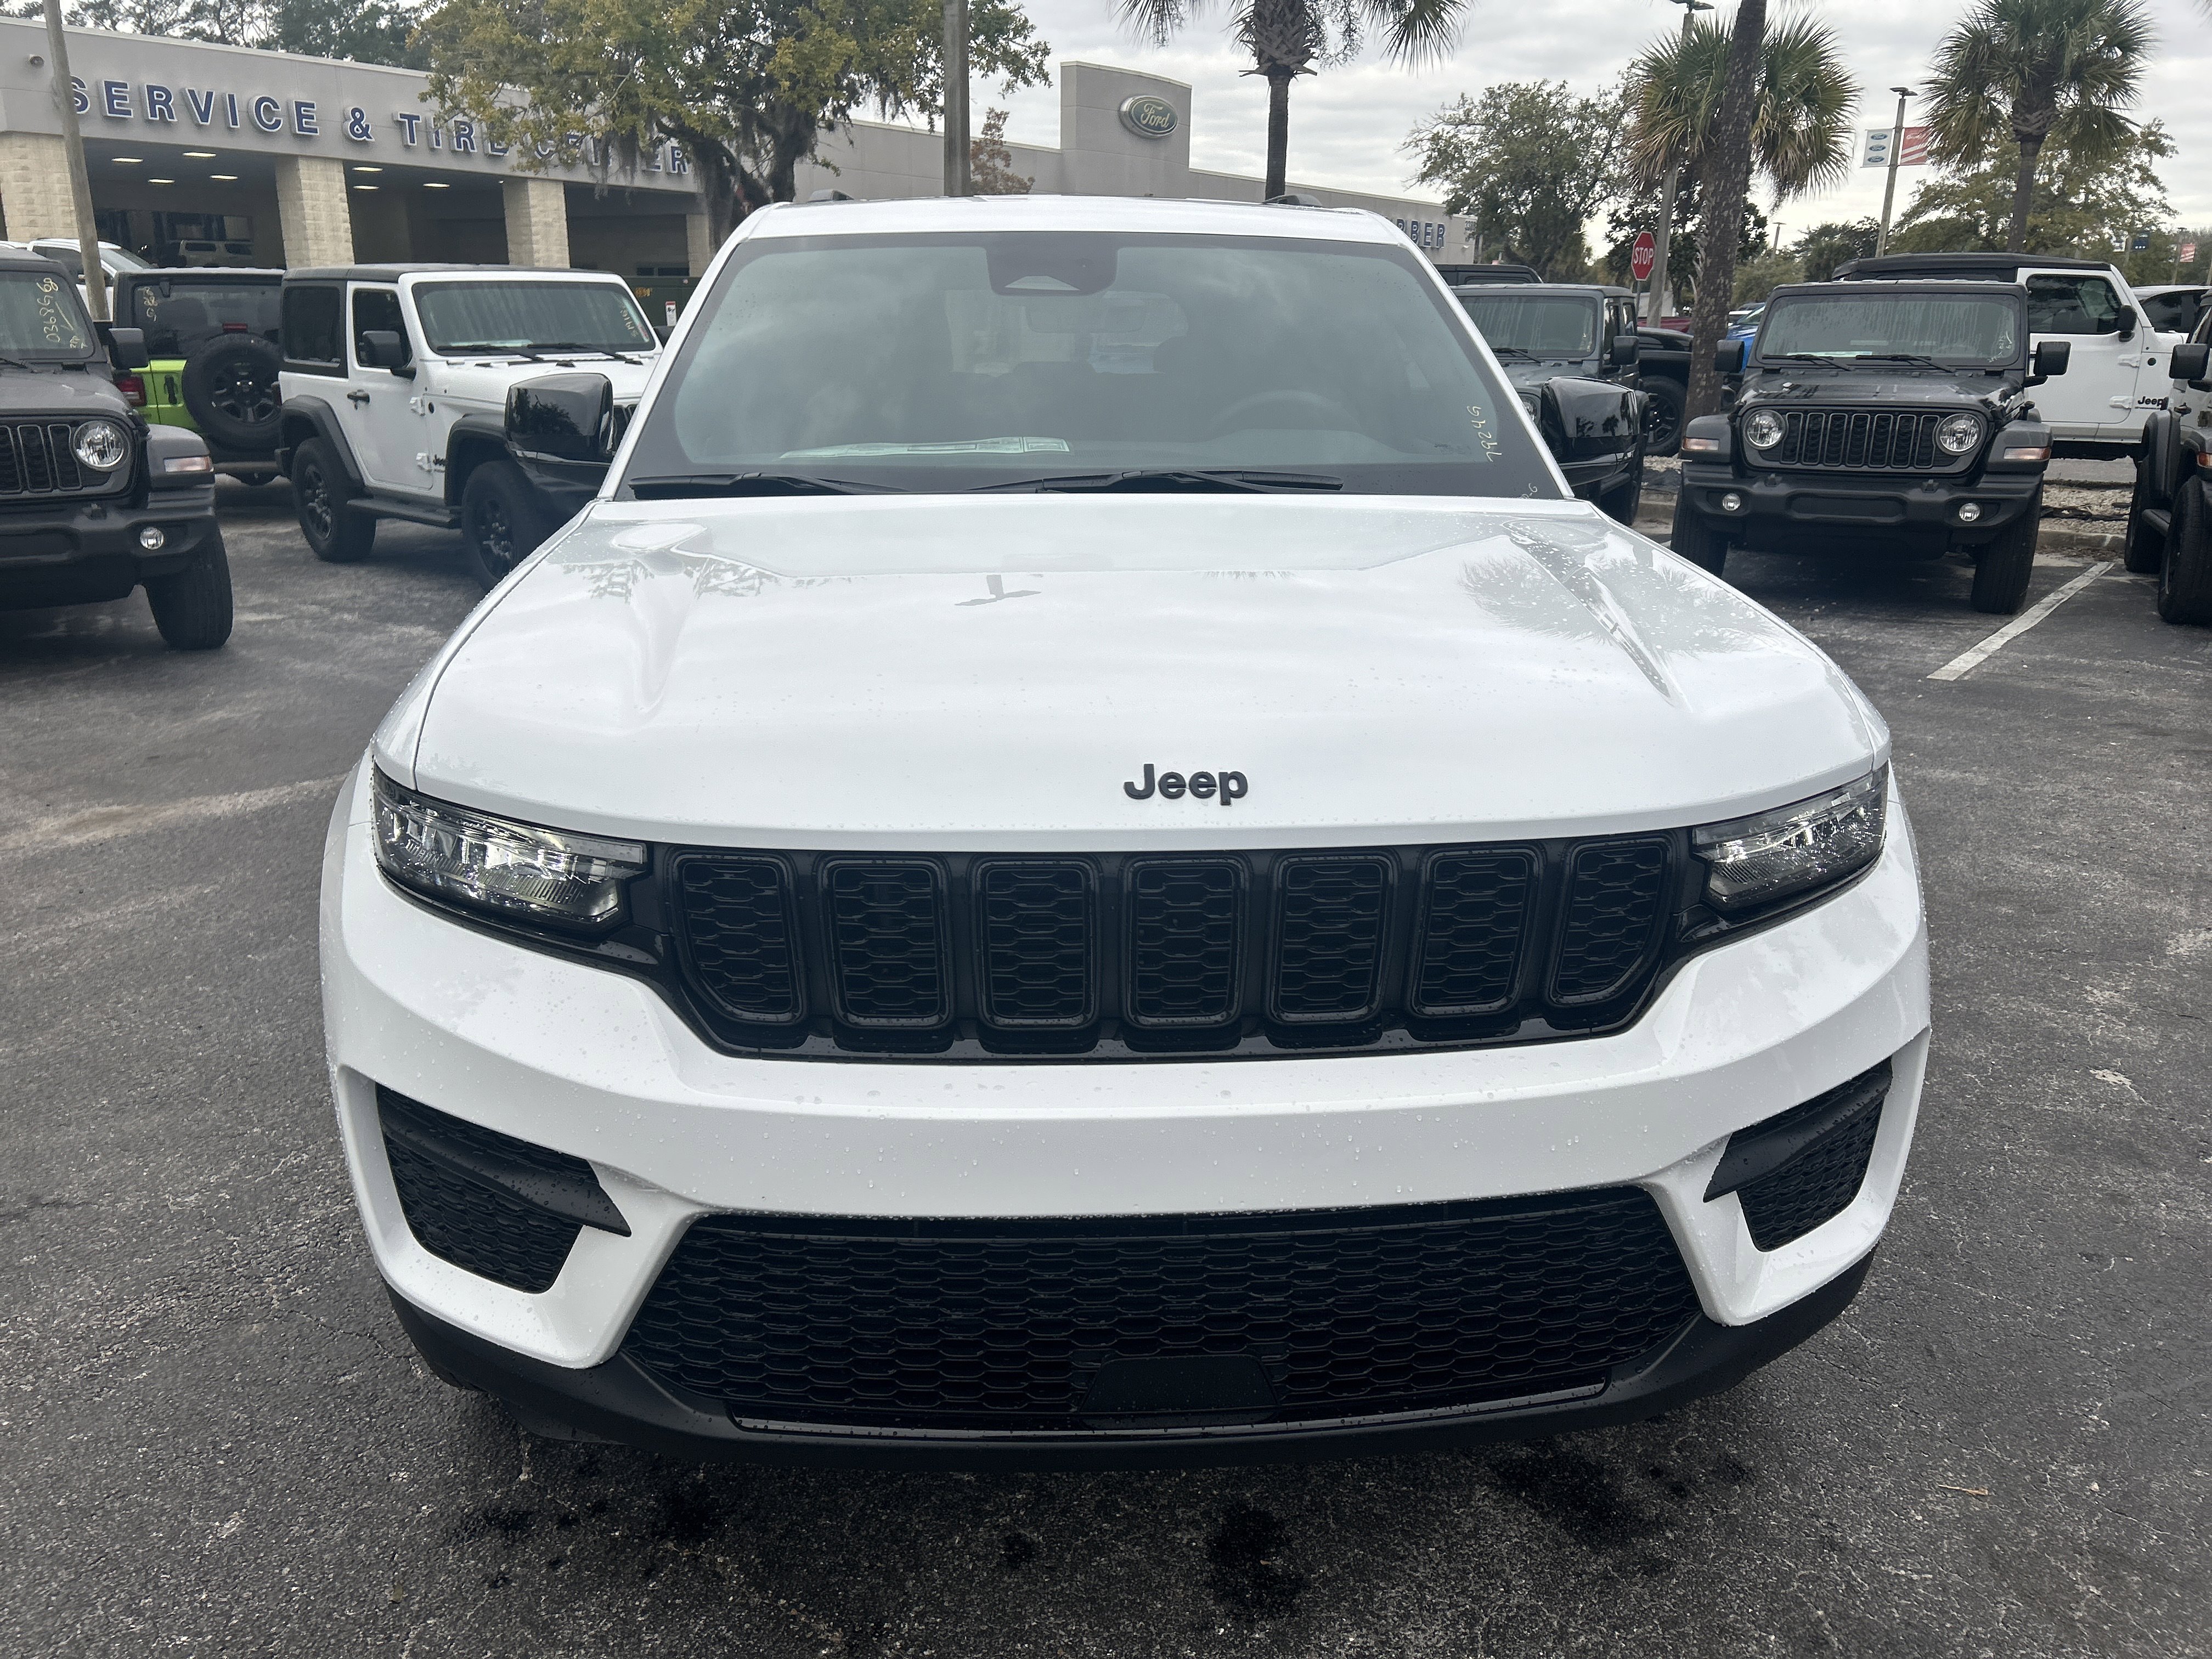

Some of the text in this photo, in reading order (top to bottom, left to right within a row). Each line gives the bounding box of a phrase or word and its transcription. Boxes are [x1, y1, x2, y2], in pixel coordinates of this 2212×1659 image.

[71, 75, 320, 136] SERVICE
[346, 106, 375, 142] &
[1141, 104, 1170, 128] Ford
[1634, 247, 1654, 265] STOP
[1124, 763, 1248, 805] Jeep
